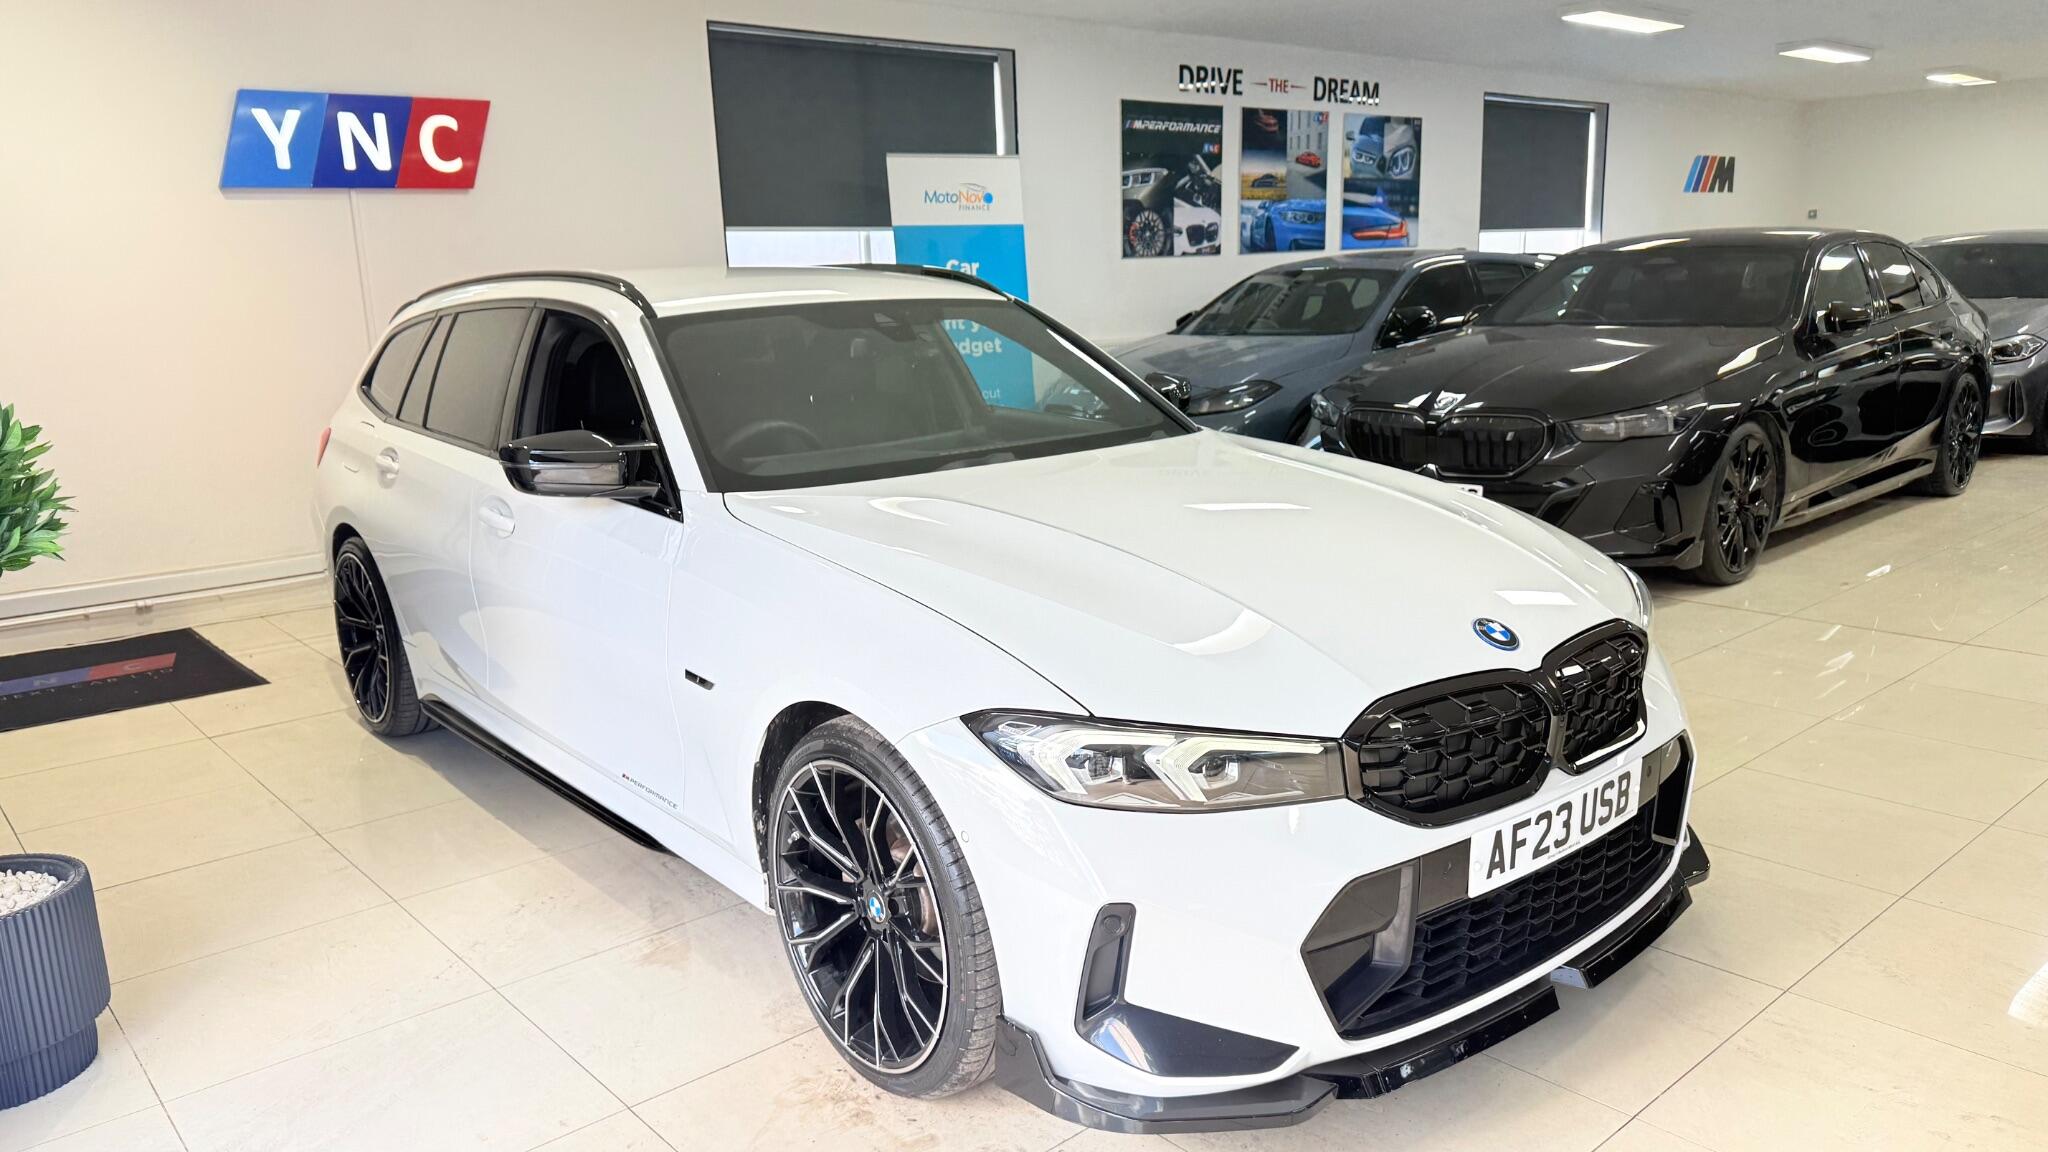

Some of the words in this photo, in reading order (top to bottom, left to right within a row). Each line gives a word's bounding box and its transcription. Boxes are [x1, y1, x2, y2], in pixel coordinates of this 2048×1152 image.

[1179, 64, 1243, 95] DRIVE
[1268, 78, 1289, 93] THE
[1313, 76, 1380, 106] DREAM
[251, 108, 463, 173] YNC
[924, 190, 994, 204] MotoNovo
[1486, 800, 1573, 880] AF23
[1580, 770, 1631, 836] USB
